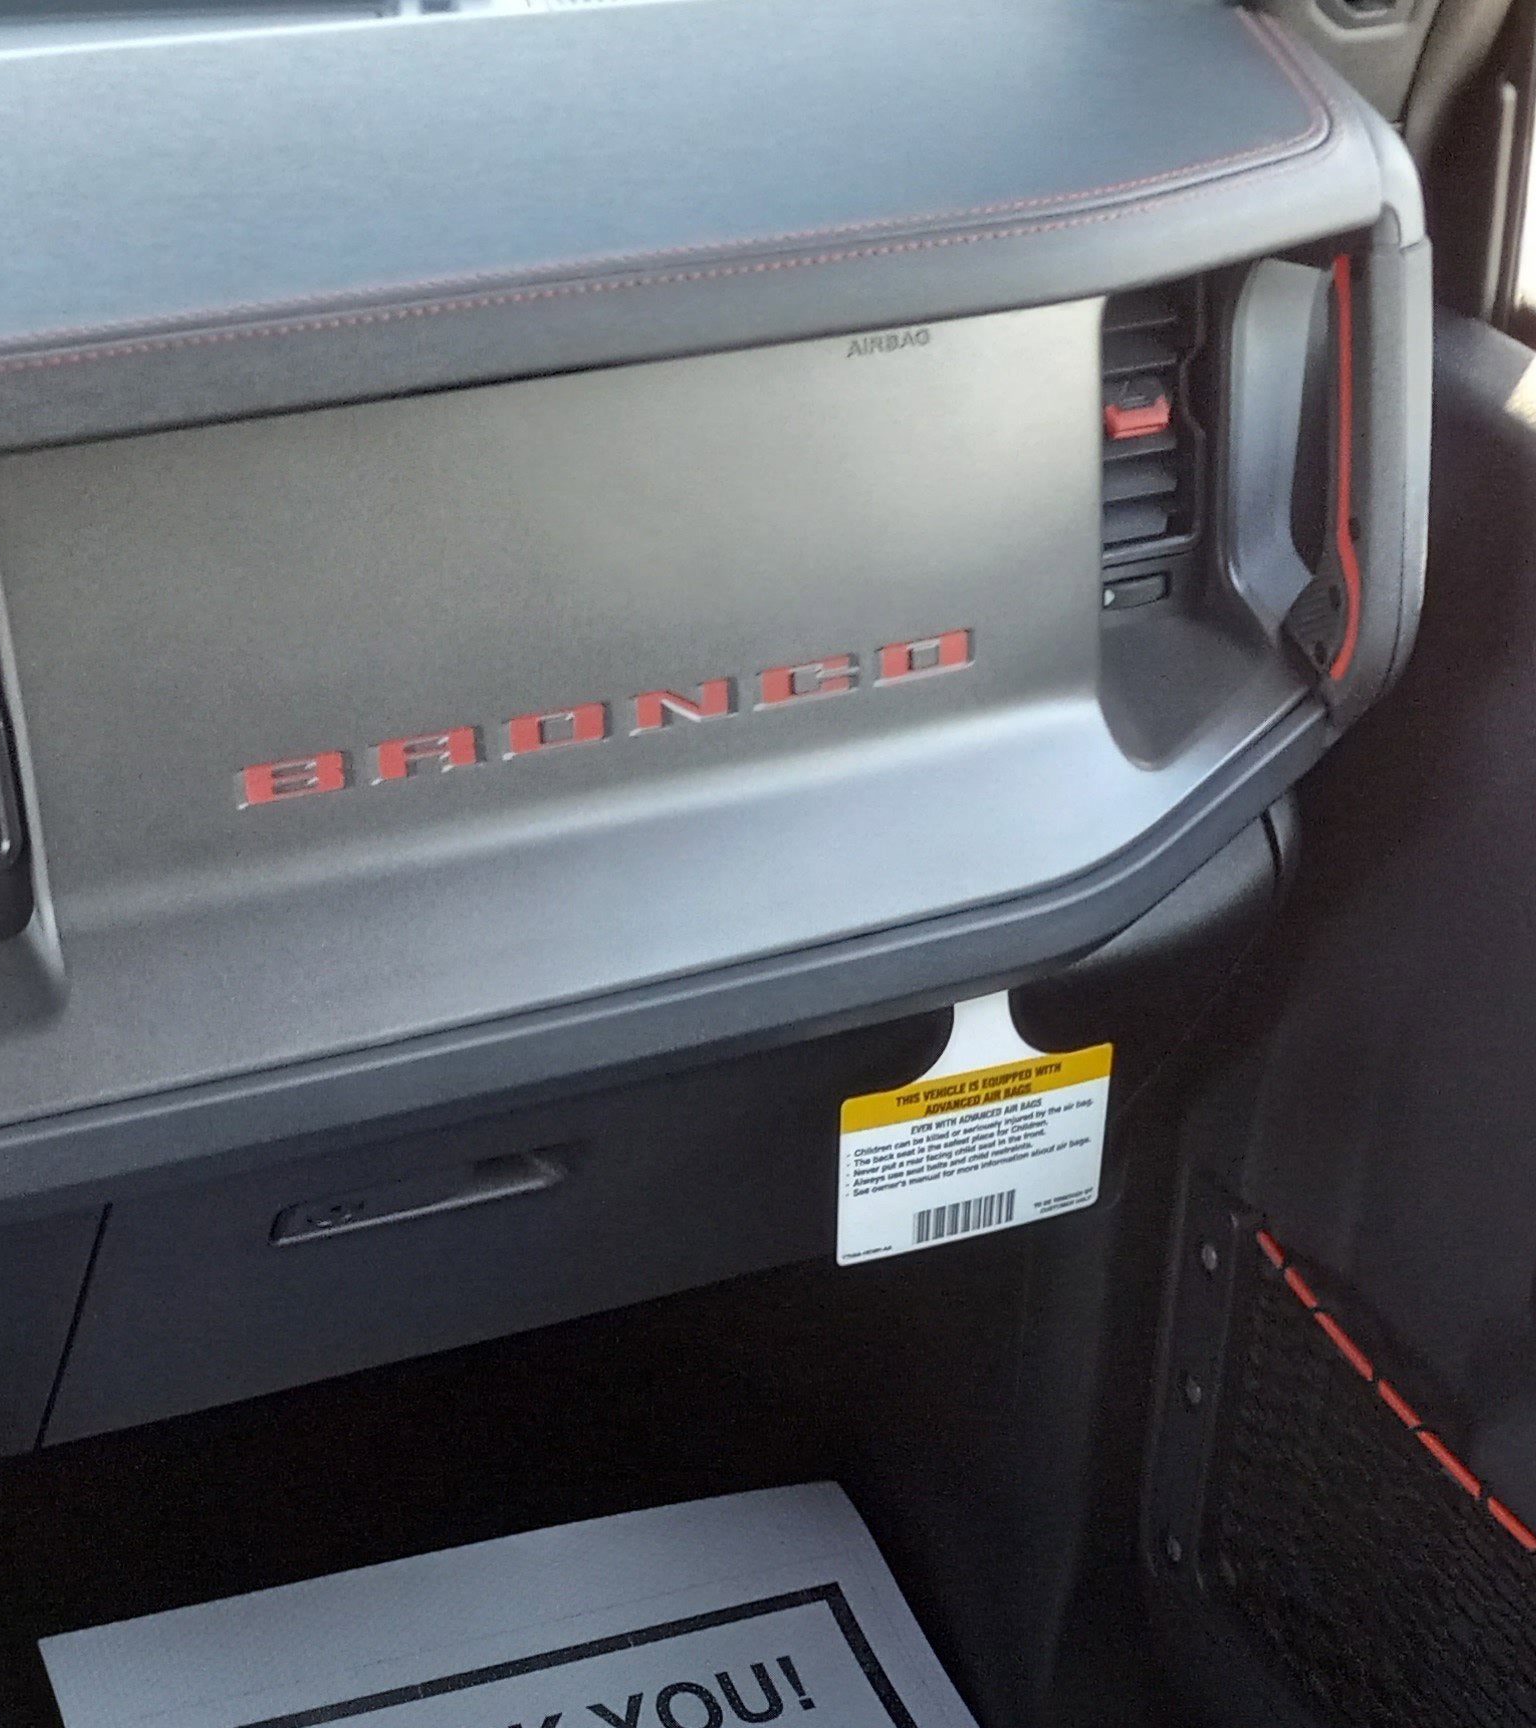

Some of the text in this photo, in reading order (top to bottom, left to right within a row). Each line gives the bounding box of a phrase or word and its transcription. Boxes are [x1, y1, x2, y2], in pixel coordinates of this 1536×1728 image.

[236, 627, 976, 810] BRONCO
[895, 1062, 1062, 1107] THIS VEHICLE IS EQUIPPED WITH
[924, 1083, 1032, 1116] ADVANCED AIR BAGS
[854, 1144, 893, 1158] Children
[894, 1140, 911, 1150] can
[912, 1136, 924, 1146] be
[926, 1131, 950, 1143] killed
[951, 1129, 961, 1137] or
[963, 1119, 1002, 1135] seriously
[1004, 1112, 1034, 1126] injured
[1035, 1108, 1046, 1119] by
[1048, 1105, 1062, 1115] the
[910, 1098, 1042, 1135] EVEN WITH ADVANCED AIR BAGS
[853, 1166, 880, 1178] Never
[881, 1162, 897, 1173] put
[906, 1157, 924, 1166] rear
[926, 1150, 953, 1164] facing
[954, 1146, 977, 1157] child
[978, 1140, 996, 1151] seat
[1008, 1134, 1022, 1144] the
[854, 1157, 871, 1167] The
[872, 1153, 894, 1164] back
[896, 1148, 915, 1159] seat
[917, 1146, 926, 1154] is
[927, 1142, 942, 1152] the
[944, 1136, 970, 1149] safest
[971, 1131, 995, 1144] place
[997, 1125, 1009, 1136] for
[853, 1174, 885, 1188] Always
[887, 1171, 904, 1180] use
[906, 1166, 924, 1177] seat
[926, 1161, 948, 1173] belts
[949, 1157, 966, 1167] and
[968, 1151, 990, 1163] child
[853, 1187, 870, 1197] See
[908, 1172, 941, 1185] manual
[943, 1168, 955, 1179] for
[956, 1163, 979, 1175] more
[980, 1152, 1030, 1169] information
[1030, 1144, 1056, 1158] about
